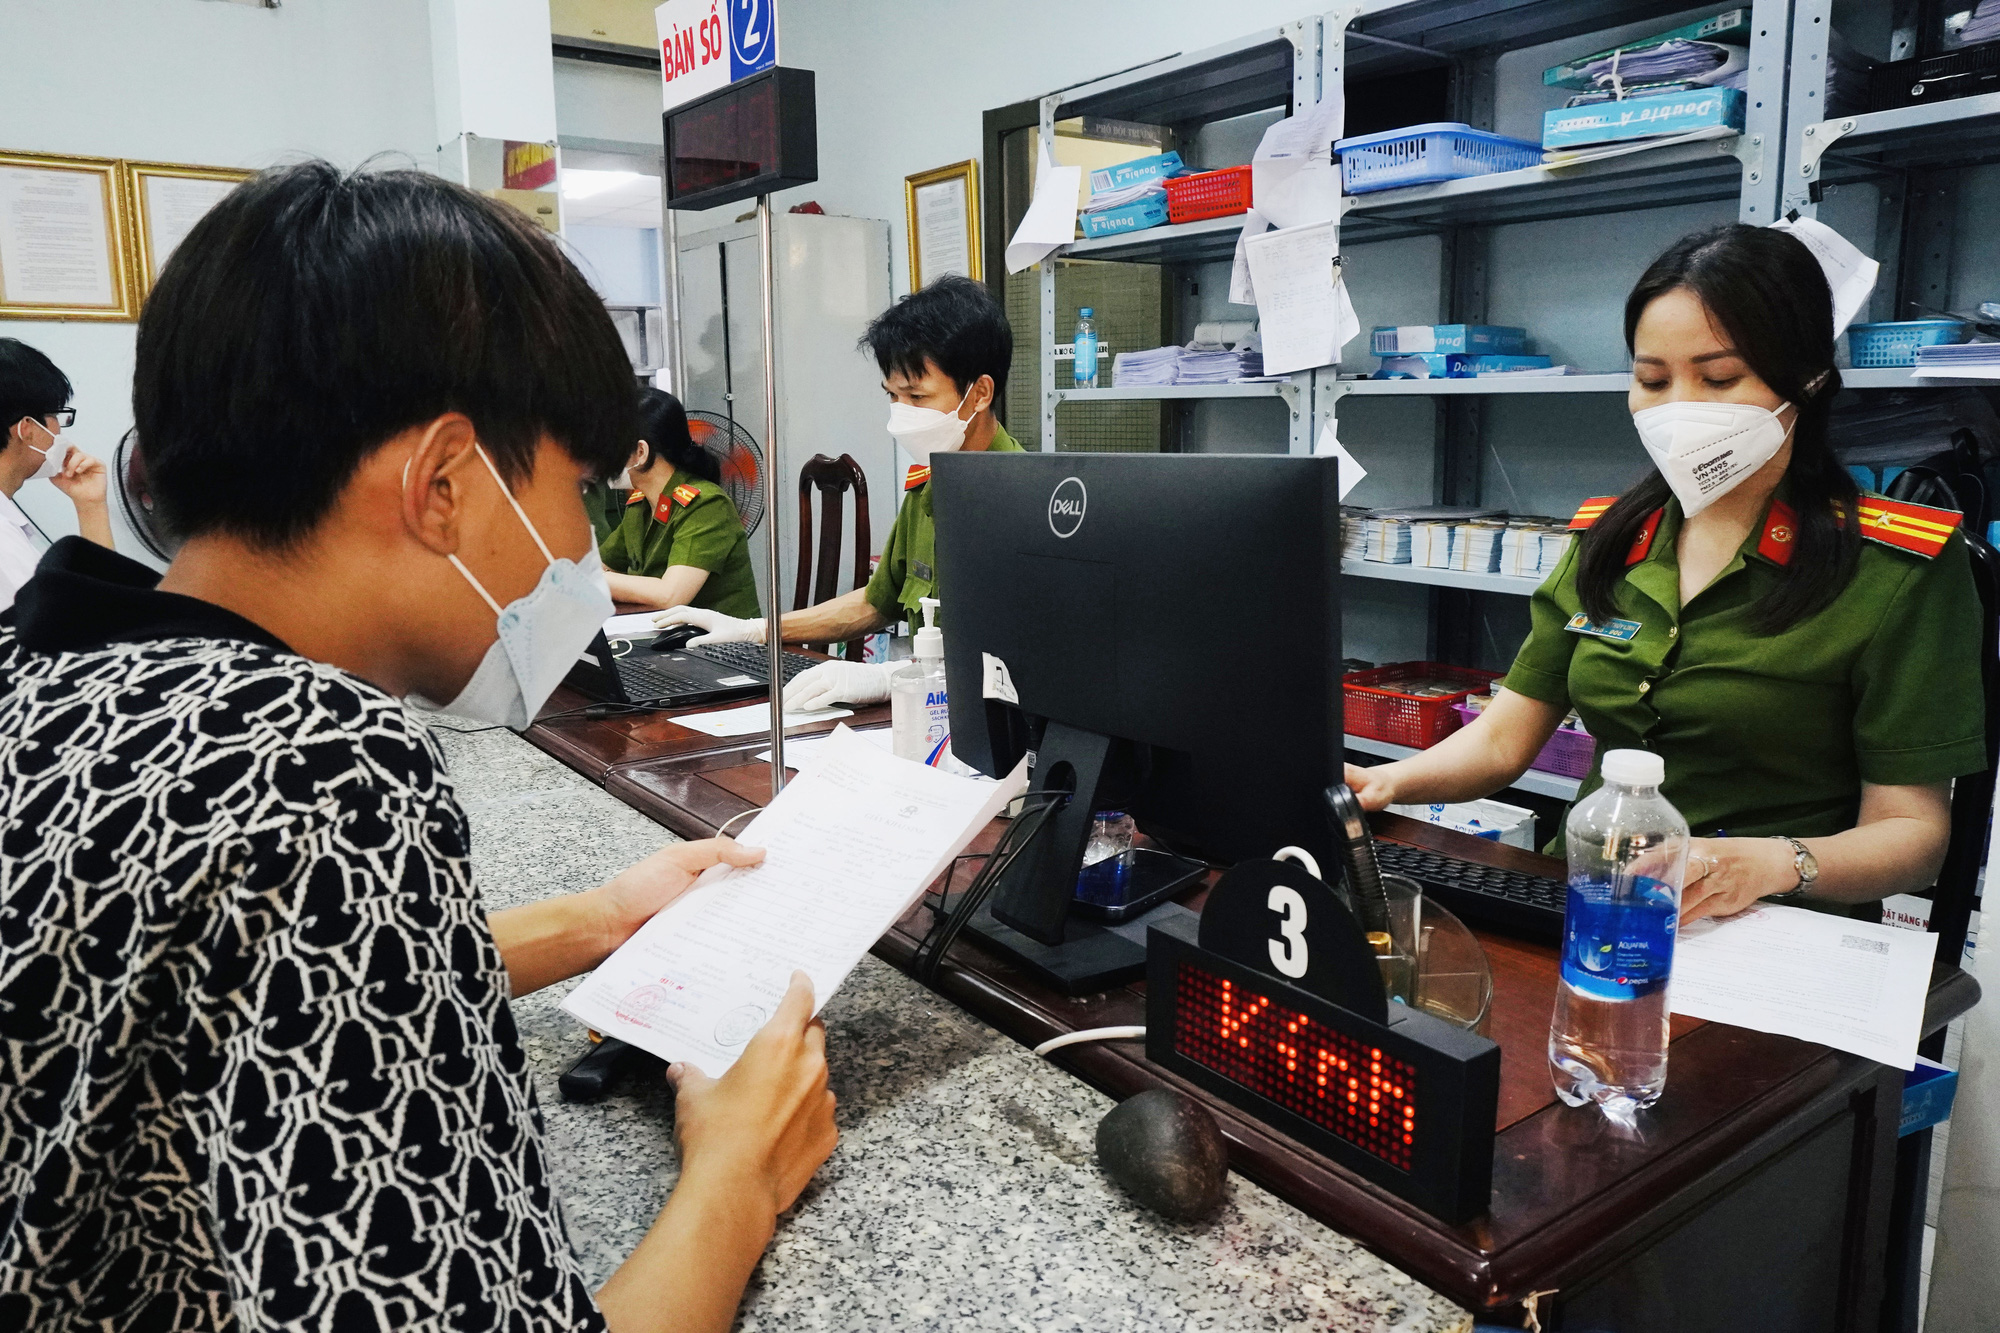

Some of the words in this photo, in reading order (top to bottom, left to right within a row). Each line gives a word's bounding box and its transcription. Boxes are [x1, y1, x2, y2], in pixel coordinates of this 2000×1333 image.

[742, 0, 760, 49] 2
[663, 23, 695, 82] BÀN
[700, 0, 722, 65] SỐ
[1621, 111, 1634, 127] A
[1640, 100, 1712, 123] Double
[1116, 174, 1123, 183] A
[1125, 165, 1157, 180] Double
[1091, 223, 1098, 232] A
[1101, 216, 1135, 230] Double
[1453, 361, 1492, 372] Double
[1695, 460, 1729, 481] VN-N95
[1053, 499, 1081, 515] DELL
[925, 690, 949, 706] Aik
[1429, 813, 1440, 822] 24
[1898, 912, 1920, 926] HÀNG
[1267, 885, 1309, 979] 3
[1618, 941, 1650, 950] AQUAFINA
[1628, 977, 1649, 986] pepsi
[1221, 979, 1415, 1145] Kính
